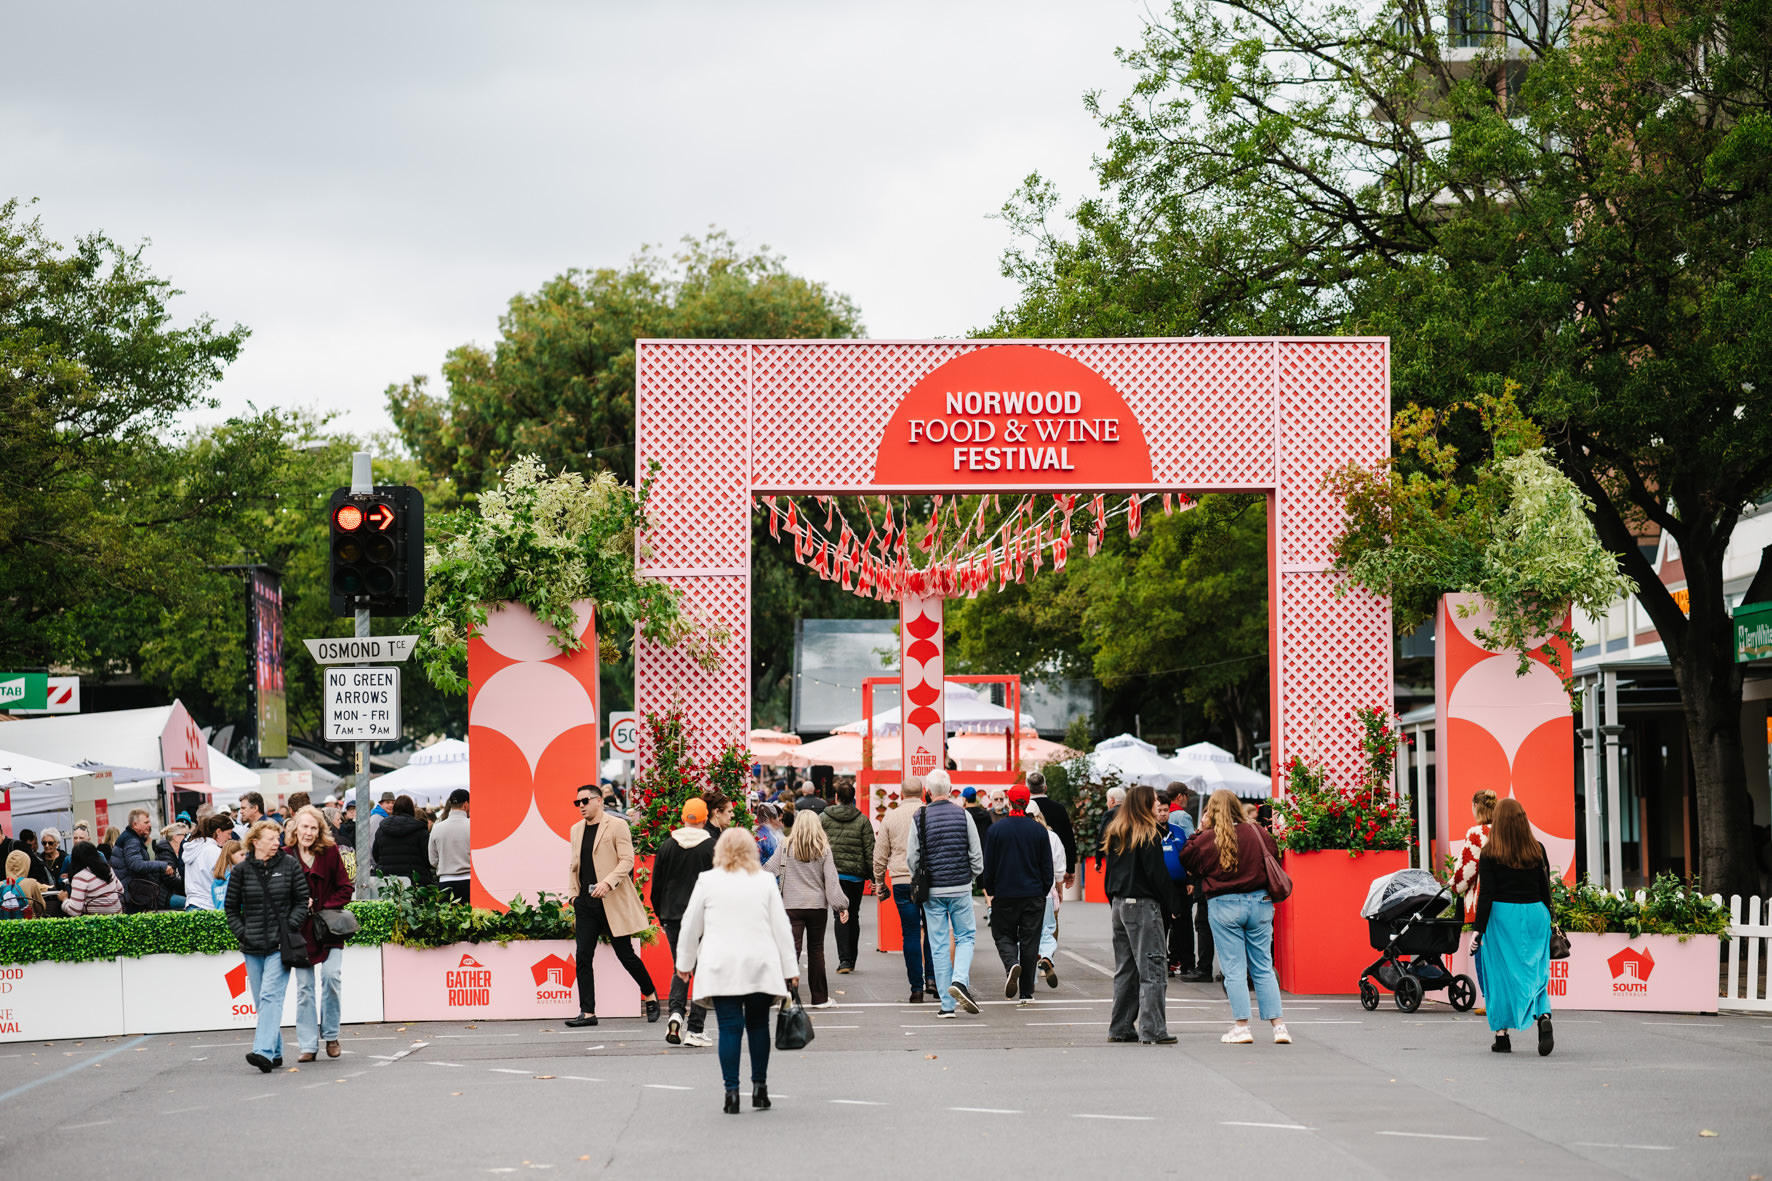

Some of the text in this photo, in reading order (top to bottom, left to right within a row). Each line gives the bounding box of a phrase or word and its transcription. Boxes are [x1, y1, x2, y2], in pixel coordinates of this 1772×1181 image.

[946, 391, 1081, 415] NORWOOD
[908, 418, 1120, 443] FOOD & WINE
[953, 447, 1075, 471] FESTIVAL
[318, 641, 380, 659] OSMOND
[330, 673, 393, 686] NO GREEN
[0, 686, 22, 696] TAB
[335, 691, 388, 704] ARROWS
[334, 710, 358, 720] MON
[371, 710, 389, 720] FRI
[334, 724, 354, 734] 7AM
[369, 724, 390, 734] 9AM
[911, 755, 937, 766] GATHER
[912, 766, 936, 776] ROUN
[446, 970, 492, 988] GATHER
[1613, 983, 1647, 992] SOUTH
[448, 989, 490, 1007] ROUND
[536, 990, 572, 1000] SOUTH
